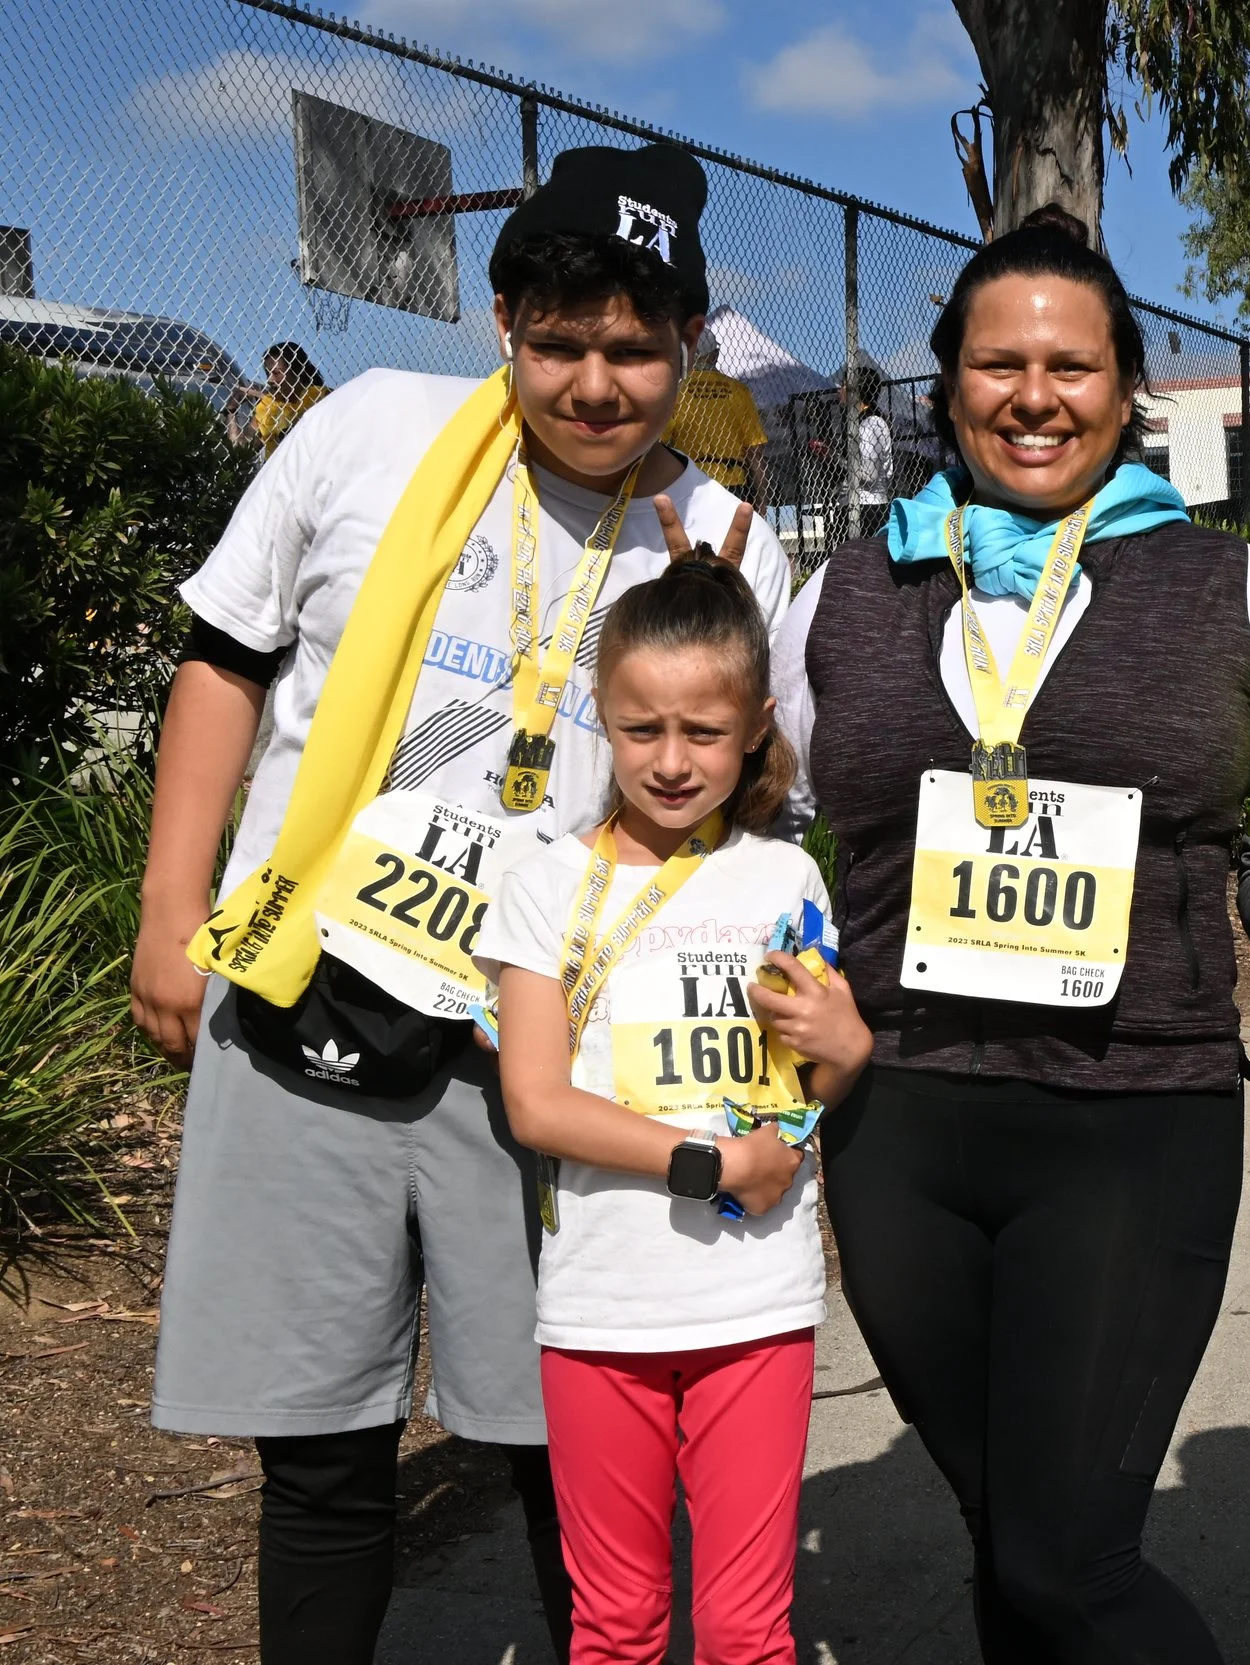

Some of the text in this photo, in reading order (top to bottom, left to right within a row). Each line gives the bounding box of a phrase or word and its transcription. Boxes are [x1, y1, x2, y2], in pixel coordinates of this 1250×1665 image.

[618, 194, 678, 229] Students
[618, 204, 677, 238] run
[616, 213, 678, 268] LA
[432, 815, 497, 849] run
[433, 804, 501, 838] Students
[986, 816, 1059, 859] LA
[415, 822, 484, 886] LA
[262, 875, 299, 921] SUMMER
[578, 872, 607, 925] SUMMER
[949, 860, 1096, 930] 1600
[611, 899, 653, 946] SUMMER
[349, 918, 469, 982] 2023 SRLA Spring Into Summer 5K
[677, 951, 747, 963] Students
[948, 937, 1086, 957] 2023 SRLA Spring Into Summer 5K
[679, 964, 748, 976] run
[1061, 965, 1105, 978] BAG CHECK
[433, 993, 470, 1015] 220
[440, 982, 480, 1003] BAG CHECK
[680, 977, 750, 1018] LA
[1060, 979, 1104, 998] 1600
[652, 1026, 771, 1087] 1601
[304, 1068, 360, 1087] adidas
